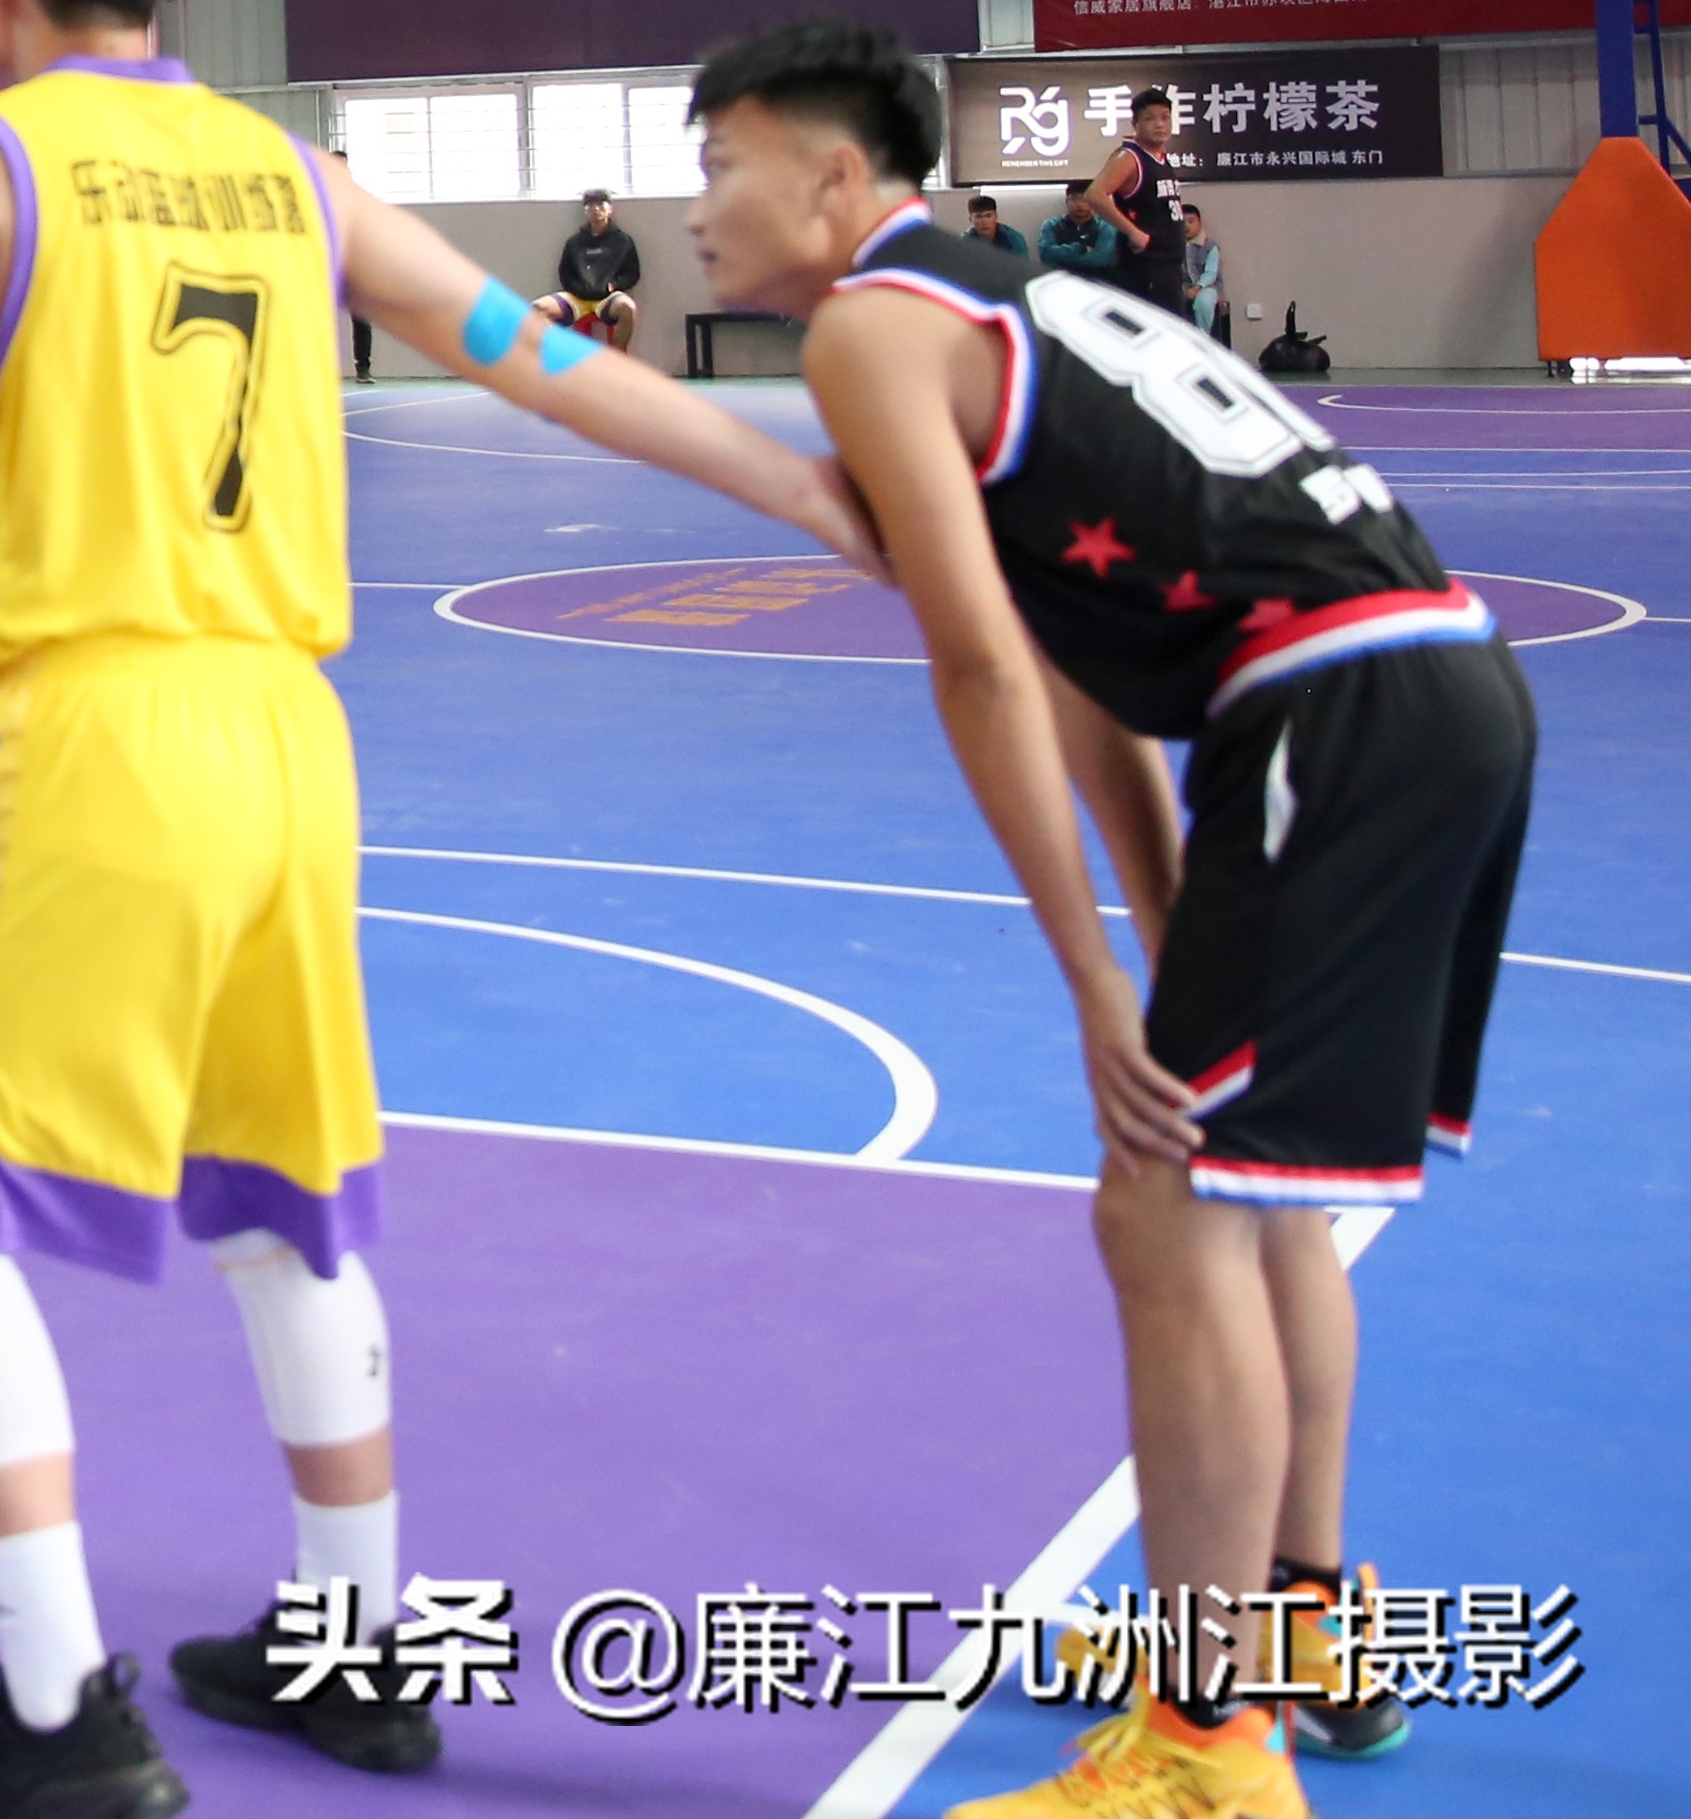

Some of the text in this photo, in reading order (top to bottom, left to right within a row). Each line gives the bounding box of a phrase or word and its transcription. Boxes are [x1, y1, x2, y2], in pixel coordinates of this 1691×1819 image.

[1217, 150, 1347, 167] 廉江市永兴国际城
[1351, 149, 1384, 166] 东门
[151, 260, 270, 532] 7
